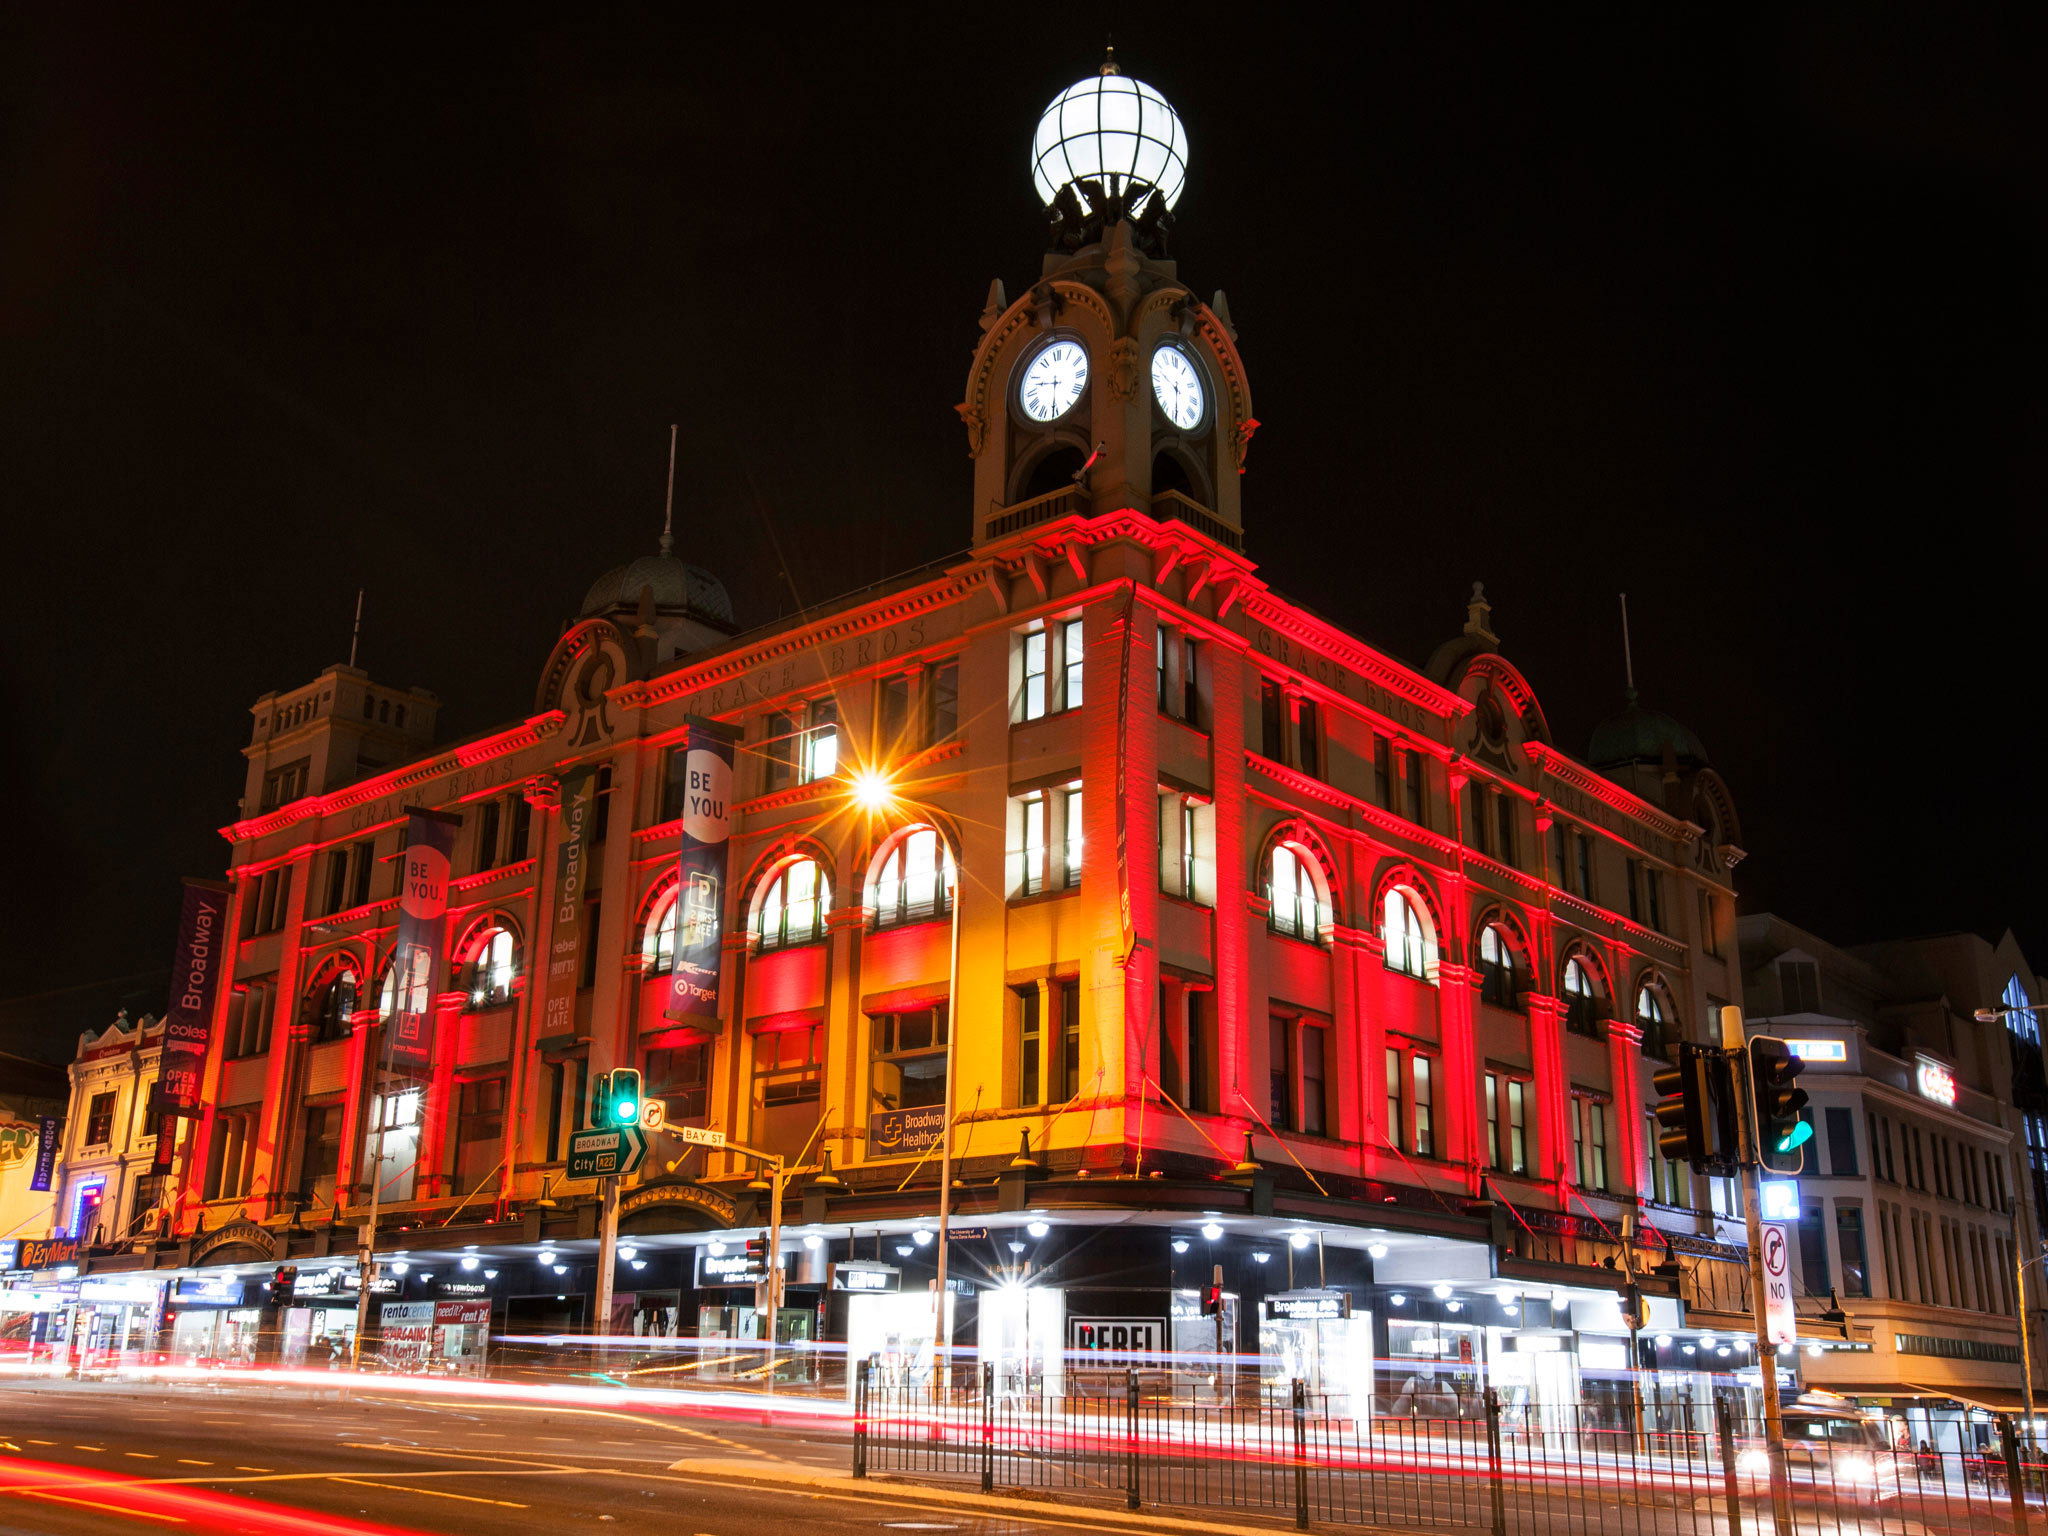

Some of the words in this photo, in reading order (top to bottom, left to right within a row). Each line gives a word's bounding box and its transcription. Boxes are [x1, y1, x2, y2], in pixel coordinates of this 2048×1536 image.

[688, 663, 798, 716] GRACE
[831, 621, 925, 673] BROS
[1258, 626, 1346, 690] GRACE
[1365, 681, 1426, 731] BROS
[691, 771, 710, 792] BE
[351, 788, 425, 829] GRACE
[450, 759, 513, 800] BROS
[691, 796, 728, 821] YOU.
[560, 794, 586, 923] Broadway
[411, 862, 428, 879] BE
[411, 882, 442, 901] YOU.
[698, 880, 711, 902] P
[554, 937, 577, 955] rebel
[181, 901, 218, 1010] Broadway
[552, 960, 576, 976] HOYTS
[676, 961, 718, 976] Kmart
[688, 983, 717, 1001] Target
[548, 996, 570, 1012] OPEN
[547, 1011, 568, 1028] LATE
[169, 1025, 208, 1039] coles
[167, 1069, 197, 1084] OPEN
[164, 1082, 193, 1096] LATE
[905, 1111, 945, 1129] Broadway
[44, 1120, 56, 1150] SYDNEY
[576, 1137, 618, 1150] BROADWAY
[685, 1130, 706, 1142] BAY
[712, 1134, 723, 1144] ST
[902, 1130, 945, 1147] Healthcare
[36, 1152, 51, 1188] CELLARS
[574, 1159, 594, 1171] City
[599, 1156, 614, 1168] A22
[32, 1241, 78, 1268] EzyMart
[1770, 1282, 1785, 1299] NO
[382, 1304, 433, 1319] rentacentre
[437, 1306, 453, 1317] need
[453, 1304, 464, 1316] it?
[460, 1310, 477, 1322] rent
[477, 1308, 489, 1323] it!
[392, 1343, 421, 1359] Rental
[1079, 1325, 1158, 1369] REBEL
